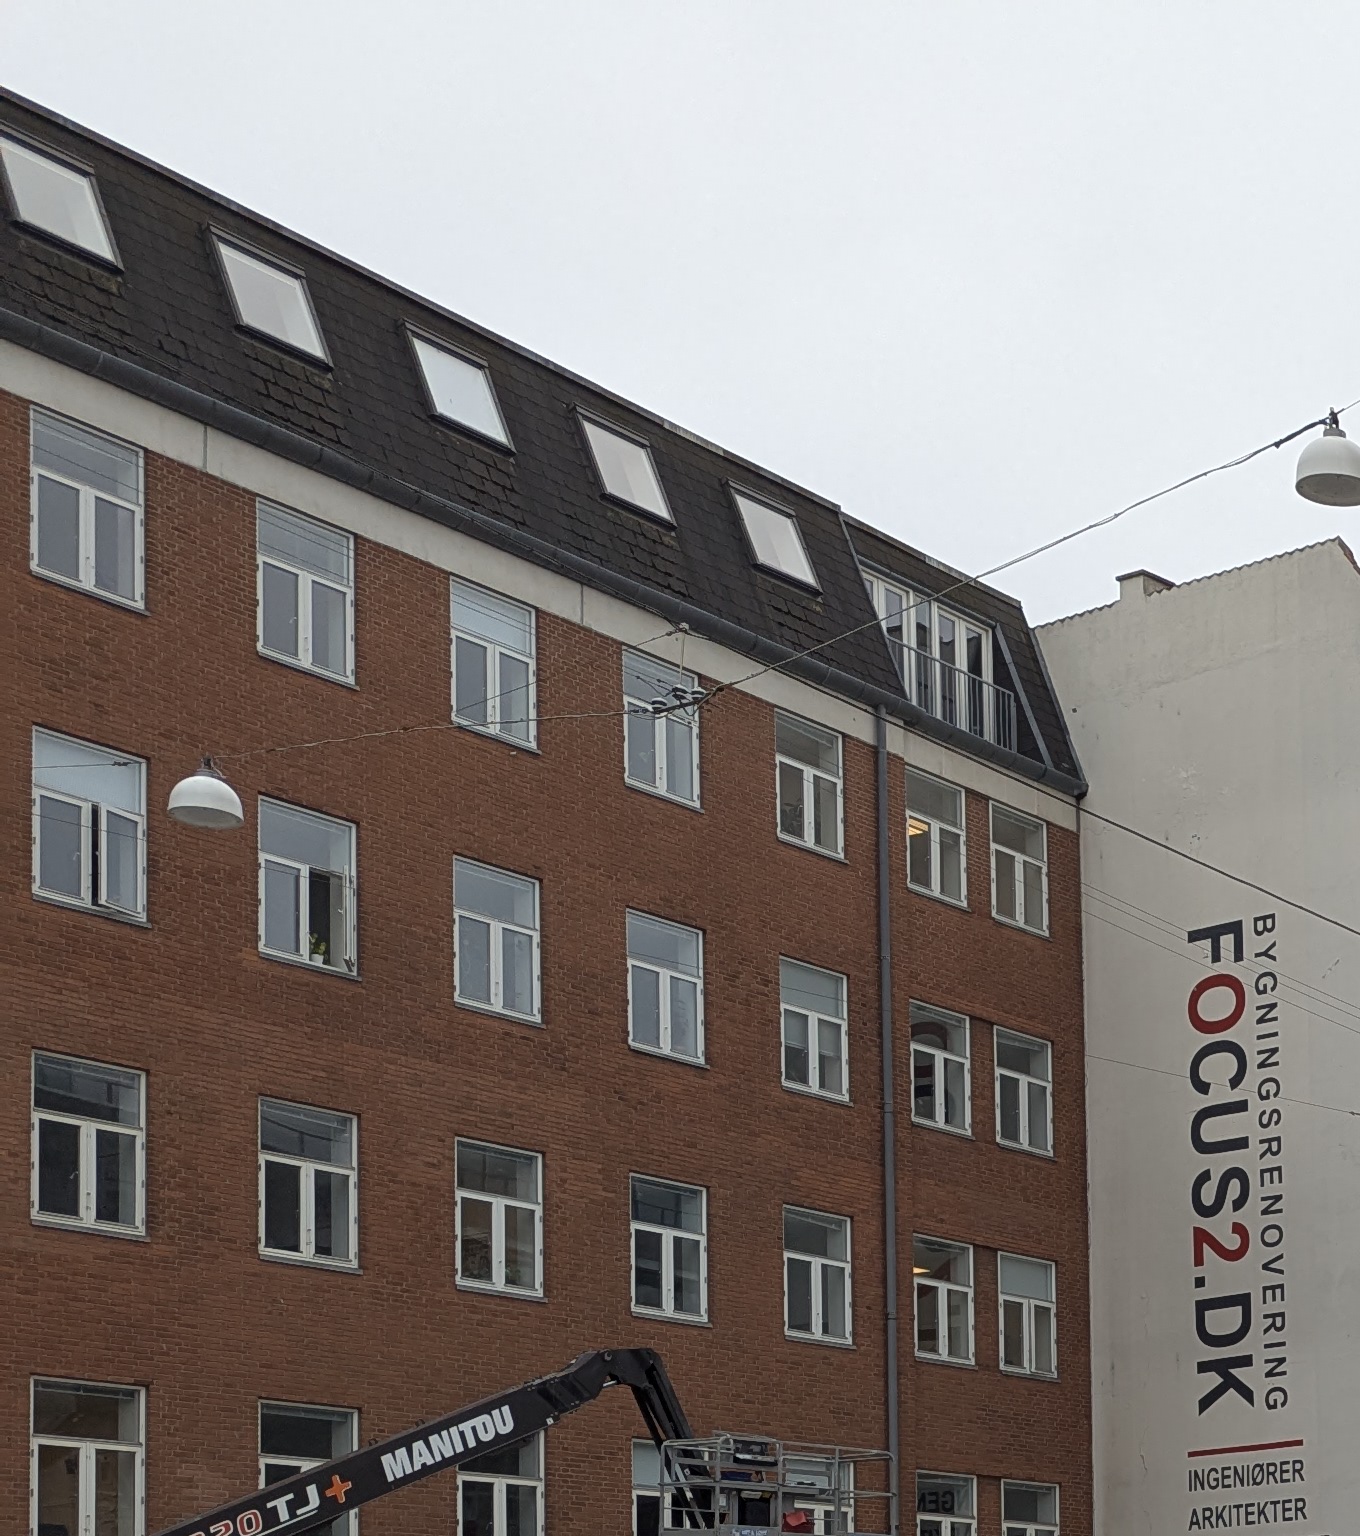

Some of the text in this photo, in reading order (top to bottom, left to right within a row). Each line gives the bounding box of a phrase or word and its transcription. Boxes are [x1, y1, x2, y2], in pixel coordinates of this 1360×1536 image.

[1187, 919, 1254, 1417] FOCUS2.DK
[1253, 912, 1288, 1411] BYGNINGSRENOVERING
[380, 1404, 515, 1483] MANITOU
[1188, 1459, 1305, 1492] INGENIØRER
[1188, 1498, 1307, 1531] ARKITEKTER
